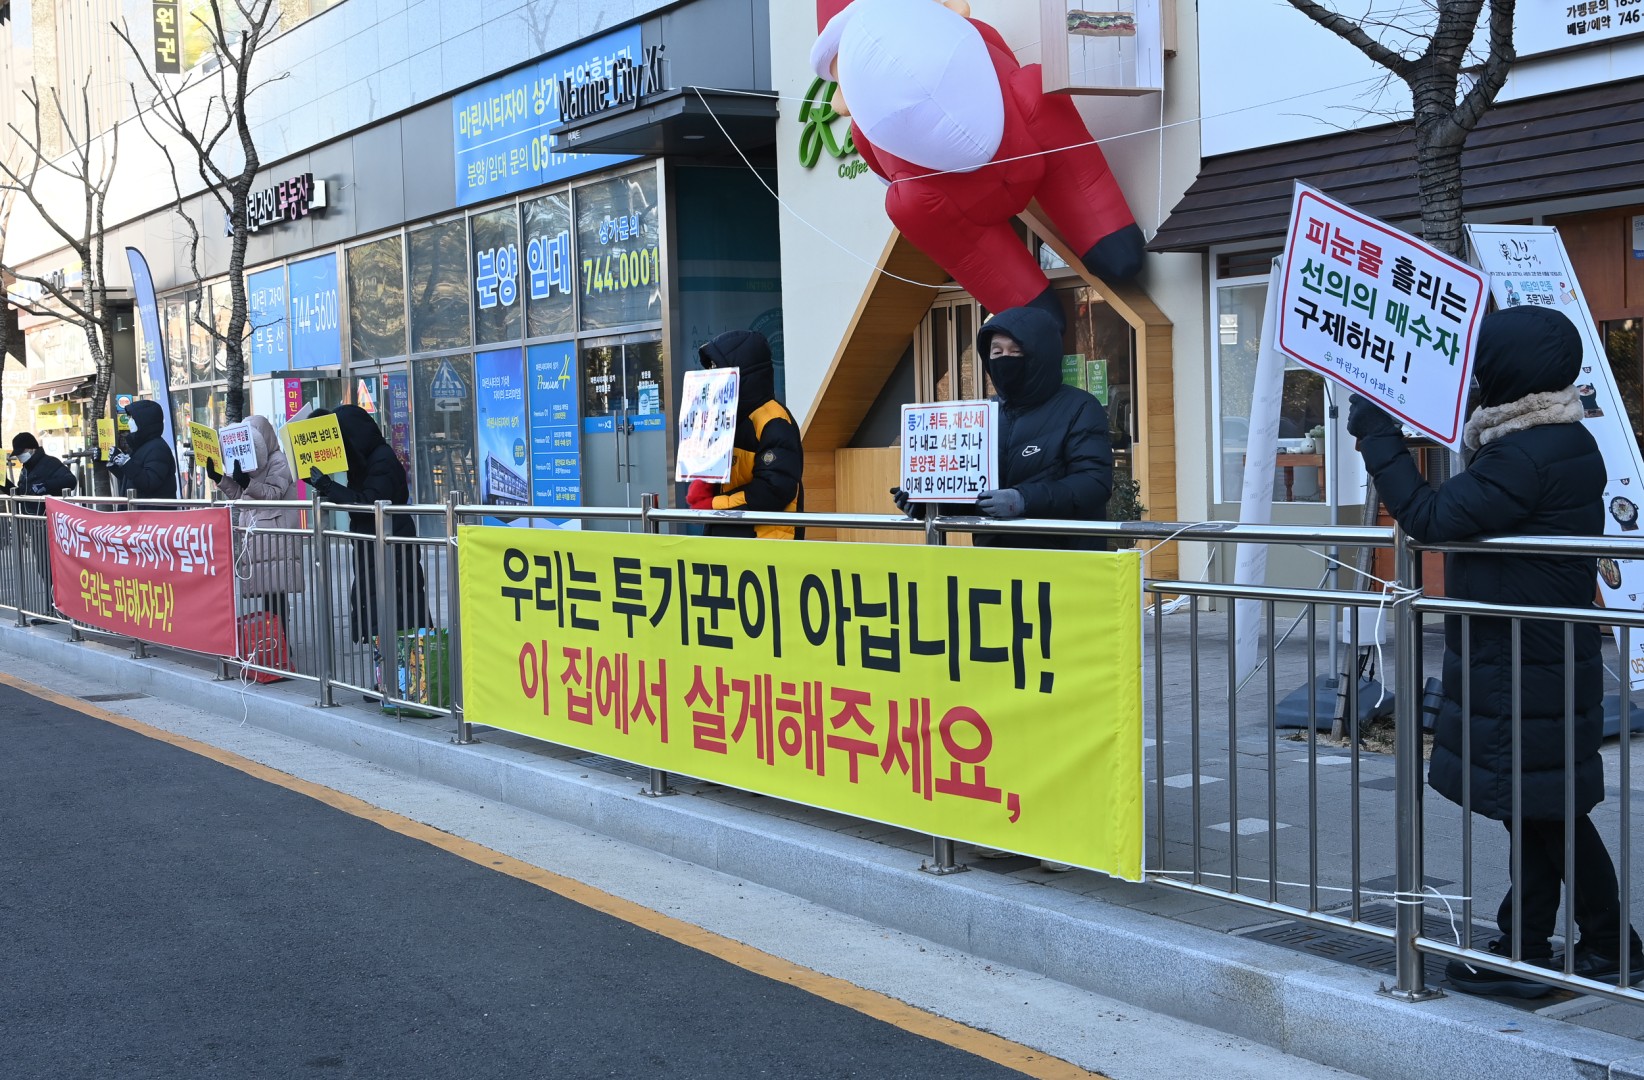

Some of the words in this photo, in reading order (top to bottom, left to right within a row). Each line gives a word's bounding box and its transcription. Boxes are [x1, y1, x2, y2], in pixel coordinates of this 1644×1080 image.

[1567, 15, 1611, 35] 배달/예약
[459, 84, 528, 139] 마린시티자이
[532, 74, 558, 115] 상가
[558, 77, 610, 122] Marine
[612, 57, 643, 109] City
[644, 45, 666, 94] Xi
[467, 151, 507, 188] 분양/임대
[509, 144, 529, 175] 문의
[838, 159, 868, 180] Coffee
[279, 172, 309, 220] 부동산
[599, 211, 642, 245] 상가문의
[477, 244, 519, 309] 분양
[527, 230, 571, 299] 임대
[583, 247, 661, 296] 744.0001
[1305, 216, 1384, 280] 피눈물
[1391, 255, 1468, 325] 흘리는
[251, 289, 267, 316] 마린
[269, 285, 285, 308] 자이
[292, 288, 338, 336] 744-5600
[1300, 257, 1378, 321] 선의의
[1385, 298, 1461, 367] 매수자
[256, 325, 285, 355] 부동산
[1293, 296, 1396, 374] 구제하라
[1336, 356, 1368, 384] 마린자이
[1369, 377, 1396, 399] 아파트
[294, 430, 319, 446] 시행사면
[318, 428, 332, 442] 남의
[332, 426, 339, 439] 집
[313, 446, 342, 462] 분양하나?
[909, 434, 918, 452] 다
[920, 433, 938, 452] 내고
[941, 433, 957, 451] 4년
[960, 432, 983, 451] 지나
[905, 476, 922, 494] 이제
[909, 454, 936, 473] 분양권
[938, 453, 980, 473] 취소라니
[127, 523, 174, 572] 취하지
[173, 523, 216, 576] 말라!
[79, 568, 113, 618] 우리는
[113, 575, 174, 633] 피해자다!
[501, 547, 602, 632] 우리는
[611, 556, 782, 659] 투기꾼이
[800, 568, 1054, 694] 아닙니다!
[518, 639, 550, 716] 이
[560, 646, 669, 744] 집에서
[683, 664, 1022, 824] 살게해주세요,
